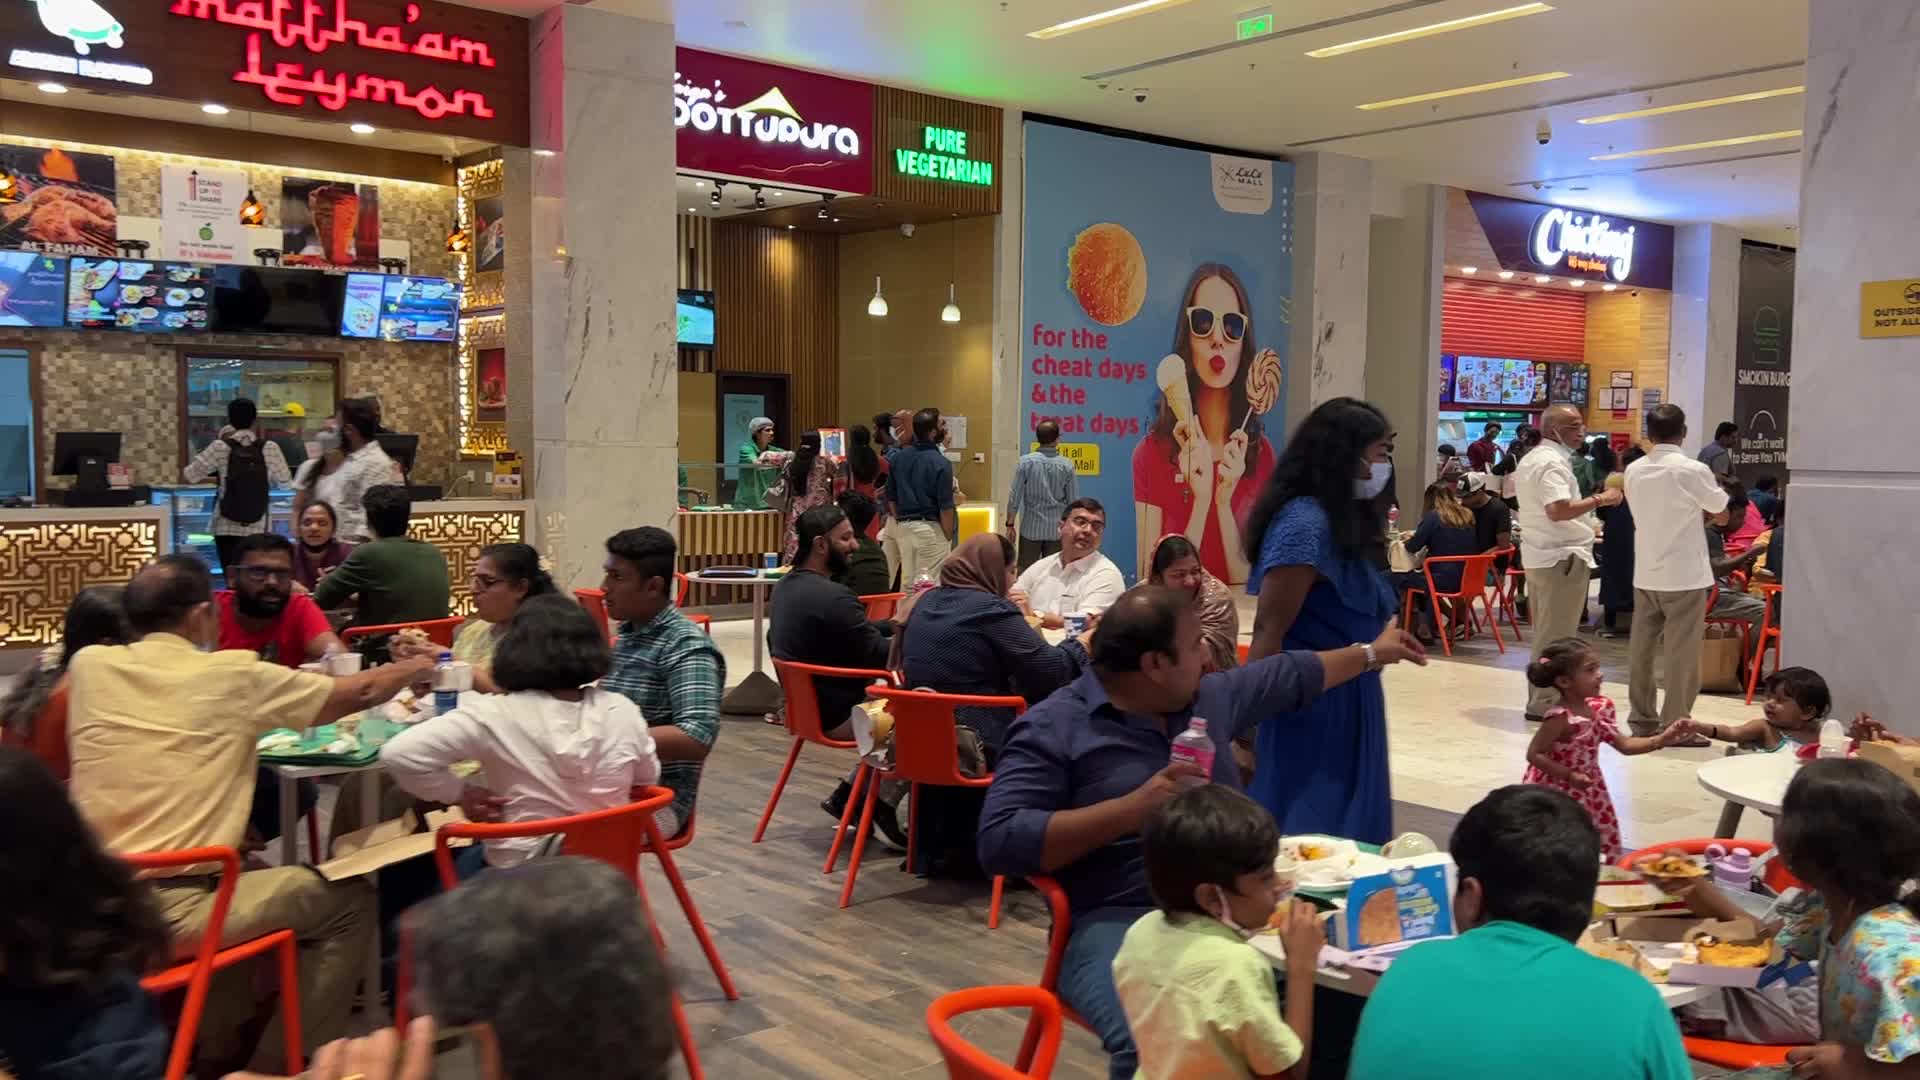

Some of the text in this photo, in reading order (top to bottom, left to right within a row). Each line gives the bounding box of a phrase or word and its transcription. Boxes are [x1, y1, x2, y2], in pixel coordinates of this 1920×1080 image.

[925, 126, 967, 155] PURE
[896, 148, 993, 186] VEGETARIAN
[44, 242, 99, 257] FAHAM
[1874, 307, 1920, 317] OUTSIDE
[1875, 319, 1898, 328] NOT
[1033, 322, 1108, 350] for the
[1032, 353, 1147, 384] cheat days
[1738, 369, 1792, 387] SMOKIN BURG
[1032, 383, 1087, 405] & the
[1090, 412, 1140, 439] days
[1741, 437, 1784, 449] We can't wait
[1071, 447, 1083, 458] all
[1741, 452, 1760, 464] Serve
[1760, 452, 1773, 463] You
[1074, 459, 1096, 472] Mall
